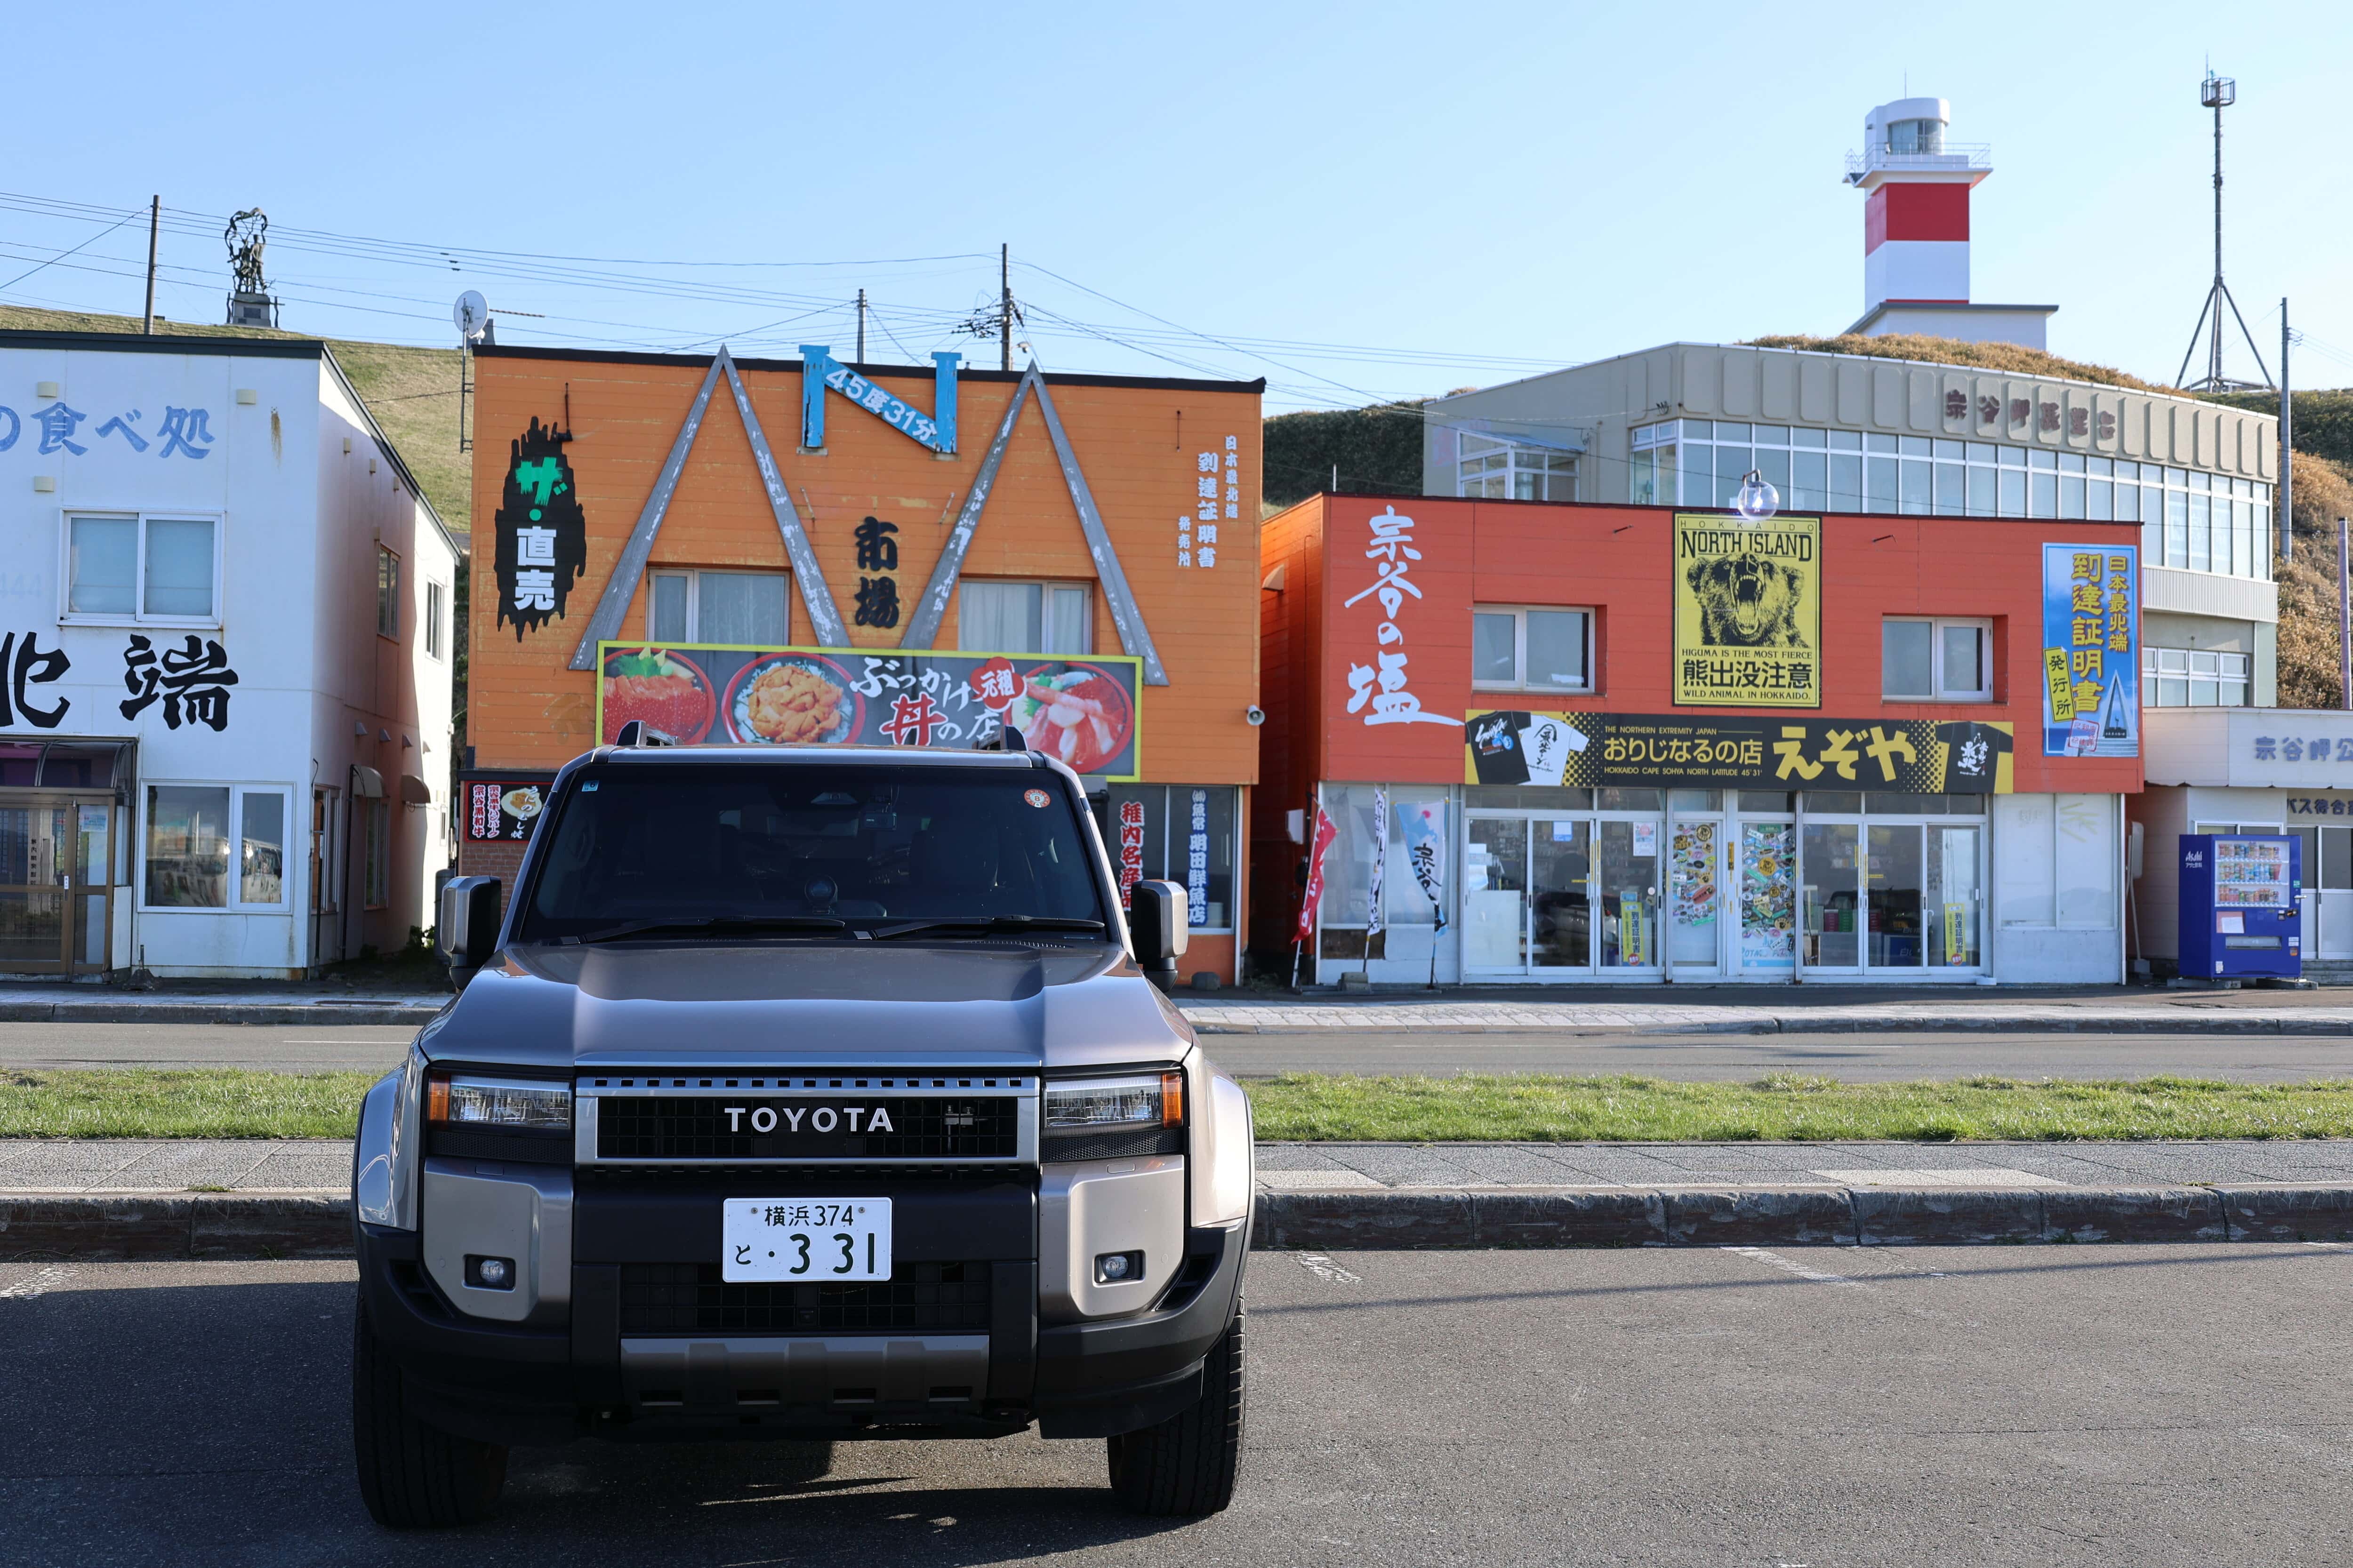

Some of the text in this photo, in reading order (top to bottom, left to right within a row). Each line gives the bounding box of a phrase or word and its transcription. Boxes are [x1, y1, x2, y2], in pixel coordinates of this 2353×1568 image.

[826, 368, 938, 442] 45度31分
[1225, 435, 1239, 519] 日本最北端
[1197, 452, 1219, 568] 到達証明書
[1680, 520, 1815, 531] HOKKAIDO
[855, 516, 899, 629] 市場
[1681, 530, 1812, 562] NORTH ISLAND
[1344, 504, 1465, 727] 宗谷の塩
[2108, 555, 2128, 652] 日本最北端
[1682, 648, 1813, 659] HIGUMA IS THE MOST FIERCE
[2072, 553, 2104, 713] 到達証明書
[0, 631, 239, 732] 北端
[849, 657, 972, 712] ぶっかけ
[980, 669, 1015, 698] 元祖
[1683, 659, 1813, 689] 熊出没注意
[1683, 689, 1706, 697] WILD
[1709, 690, 1744, 698] ANIMAL
[1748, 691, 1757, 699] IN
[2049, 655, 2071, 716] 発行所
[1604, 737, 1763, 765] おりじなるの店
[1620, 726, 1656, 734] NORTHERN
[1773, 726, 1917, 782] えぞや
[2255, 736, 2353, 762] 宗谷岬公
[1604, 766, 1639, 774] HOKKAIDO
[1662, 767, 1684, 775] SOHYA
[1687, 768, 1709, 776] NORTH
[1711, 768, 1738, 776] LATITUDE
[472, 784, 486, 838] 宗谷黒和牛
[487, 784, 501, 838] 宗谷黒牛ハンバーグ
[2185, 850, 2202, 862] Asahi
[724, 1107, 893, 1132] TOYOTA
